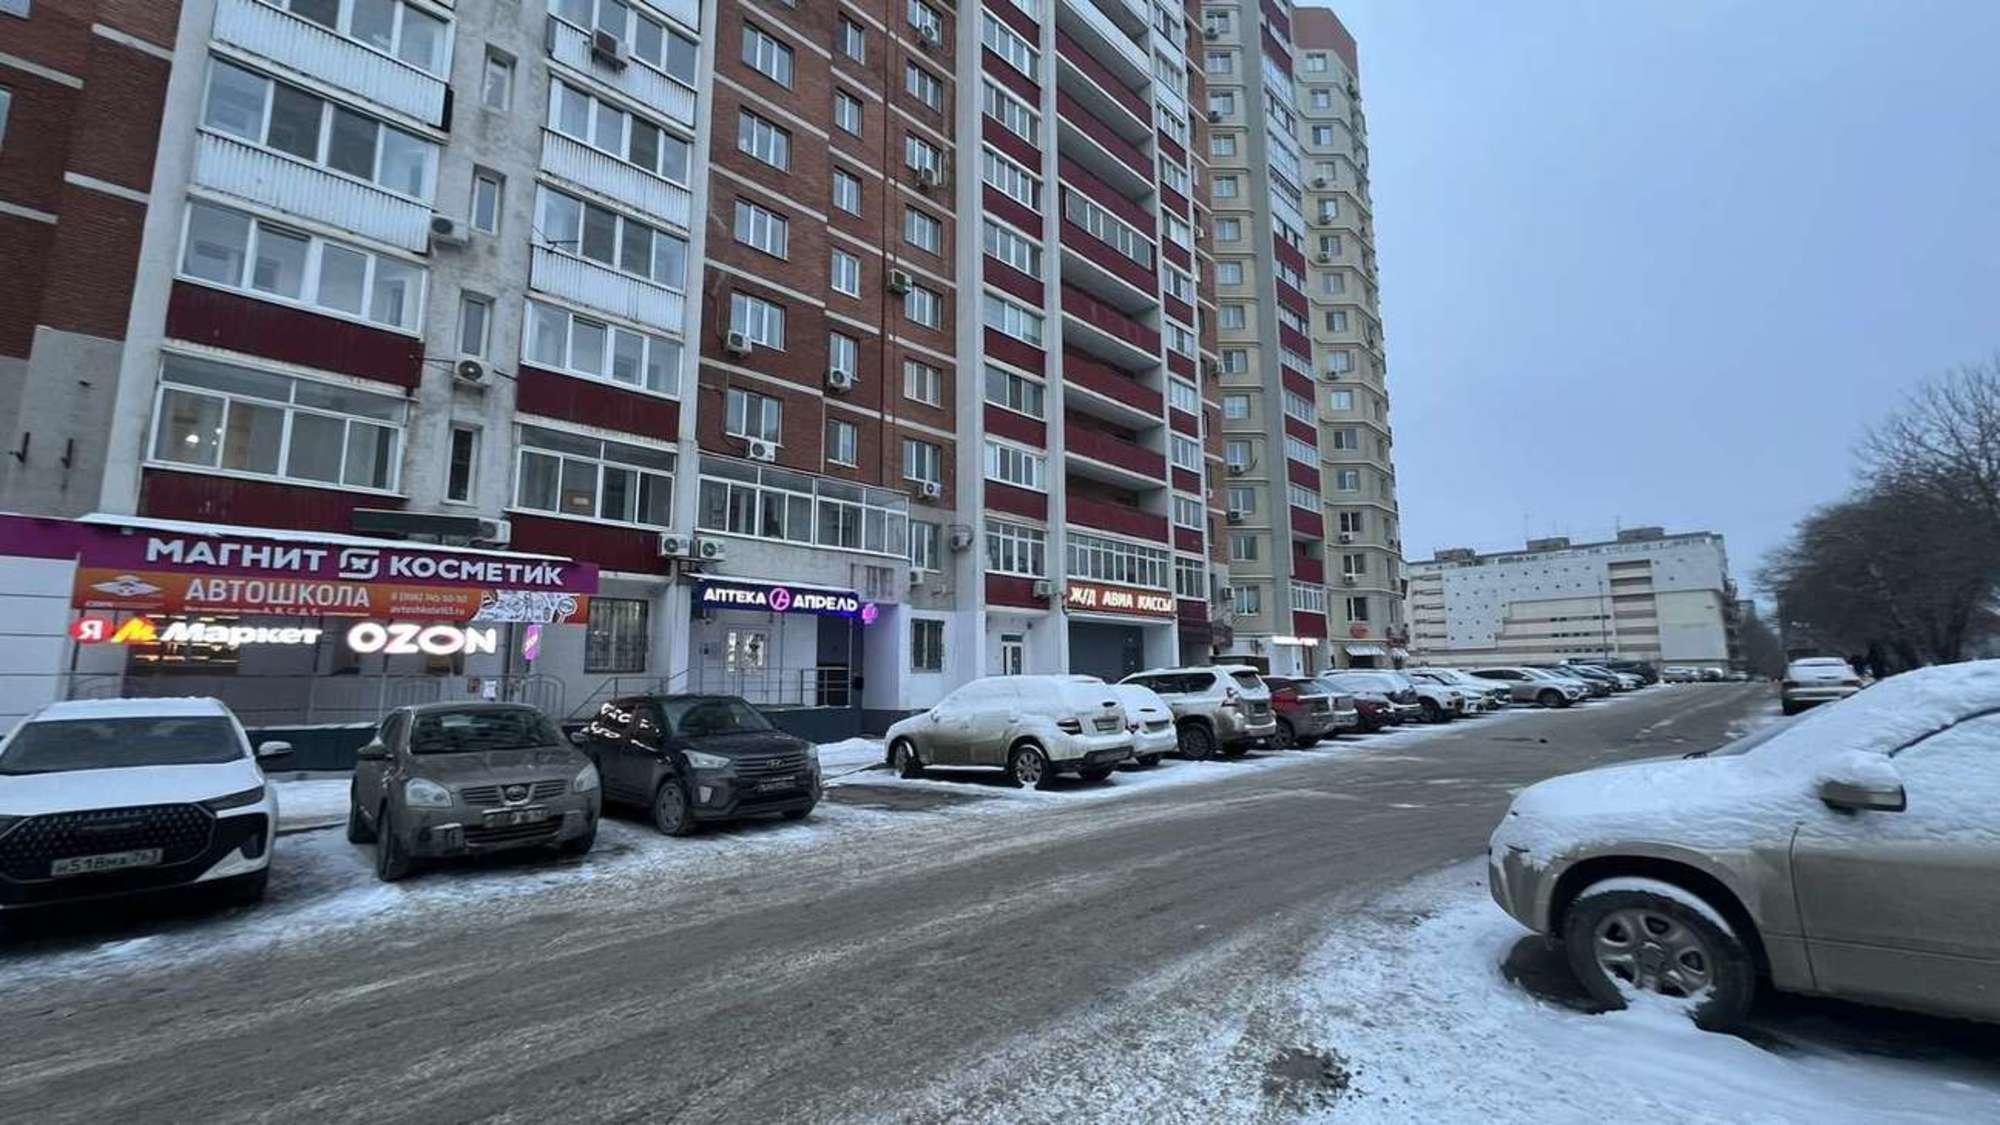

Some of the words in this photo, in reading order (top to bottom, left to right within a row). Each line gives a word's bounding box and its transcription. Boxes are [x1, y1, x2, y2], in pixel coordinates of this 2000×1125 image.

[146, 537, 327, 572] МАГНИТ
[389, 555, 565, 586] КОСМЕТИК
[185, 578, 370, 607] АВТОШКОЛА
[703, 588, 767, 605] АПТЕКА
[792, 595, 859, 612] АПРЕЛЬ
[1070, 587, 1097, 607] Ж/Д
[1102, 591, 1133, 608] АВИА
[1137, 595, 1173, 612] КАССЫ
[78, 619, 101, 639] Я
[159, 621, 322, 646] Маркет
[347, 622, 497, 655] OZON
